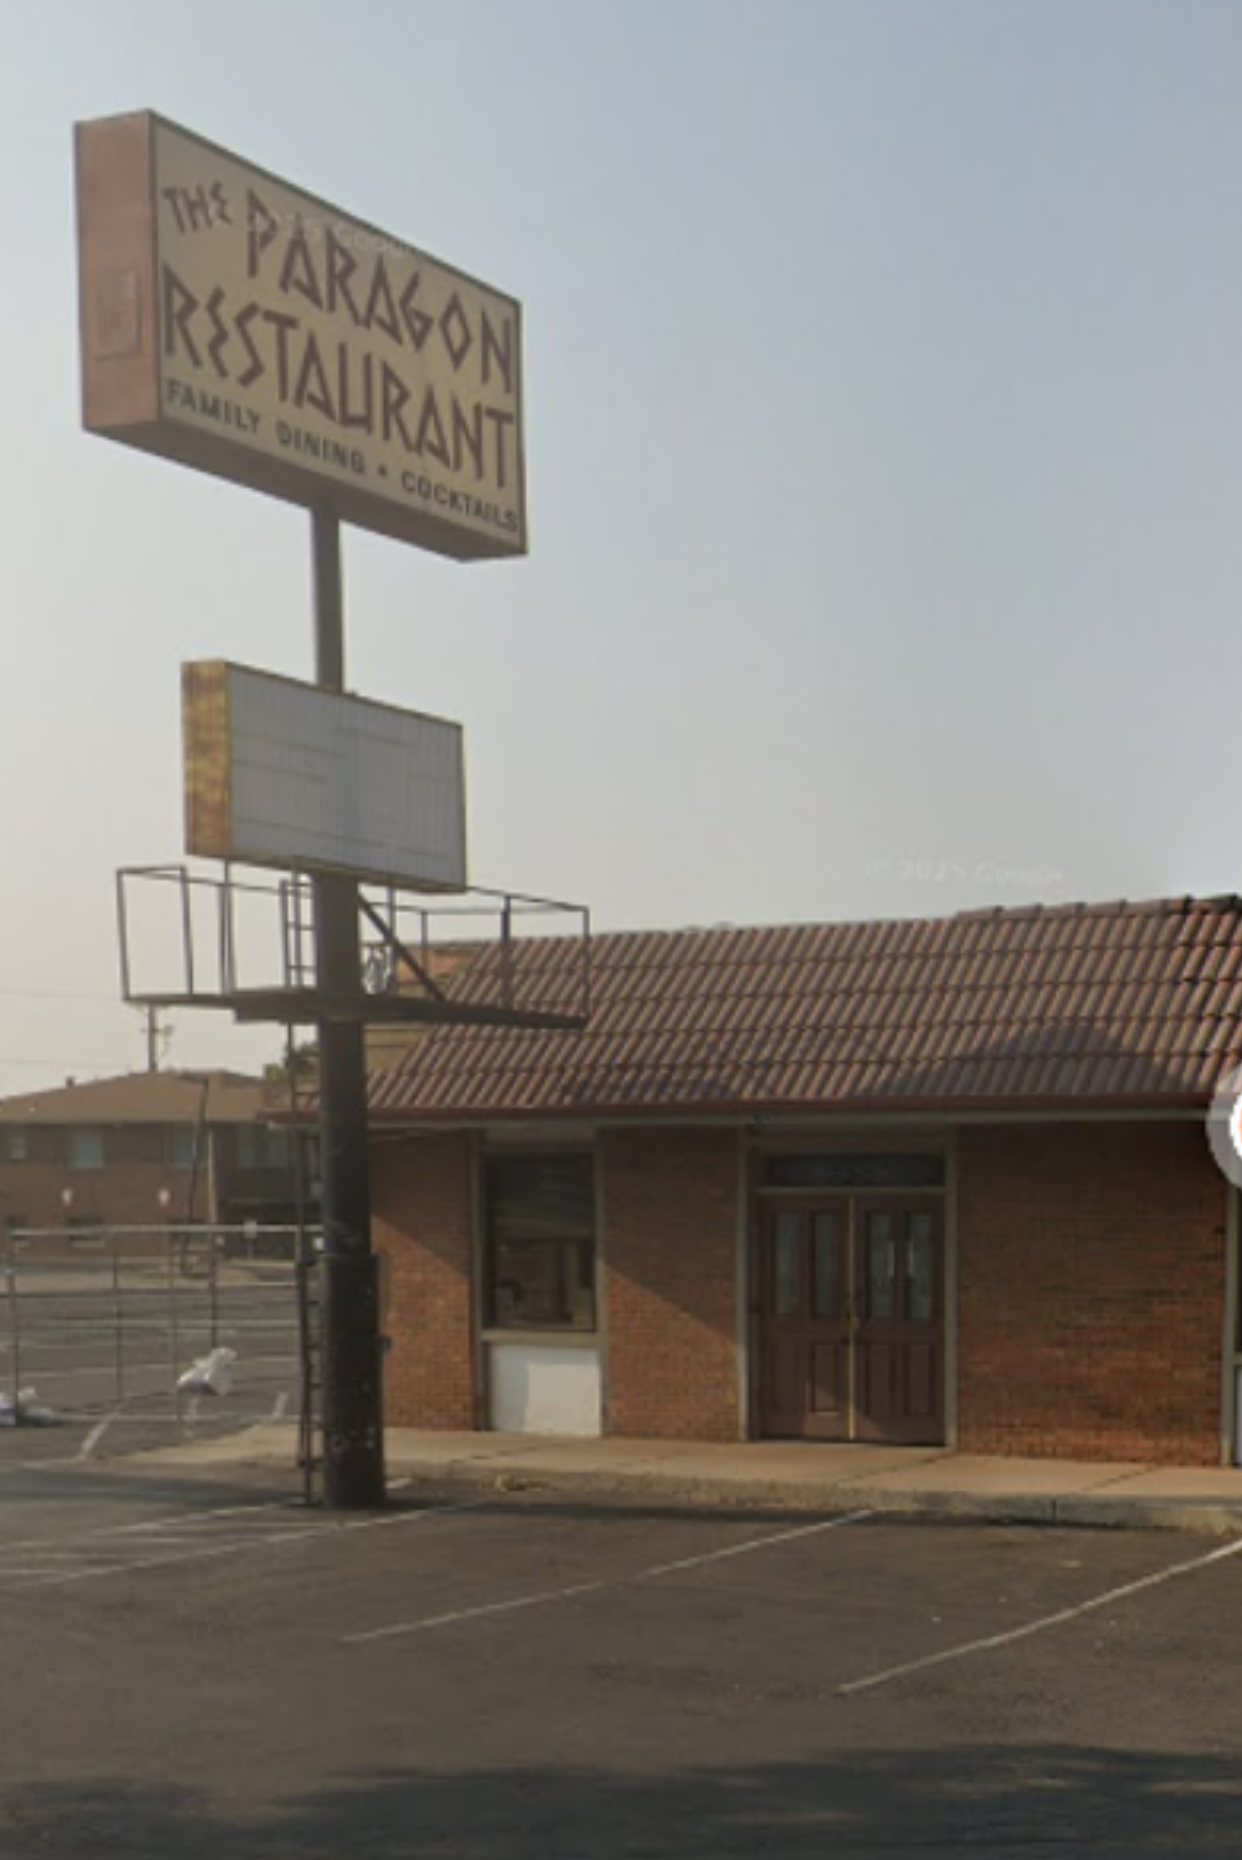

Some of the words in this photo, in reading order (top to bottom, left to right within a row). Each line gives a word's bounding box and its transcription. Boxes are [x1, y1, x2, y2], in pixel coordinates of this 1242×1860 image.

[162, 181, 233, 235] THE
[247, 187, 513, 394] PARAGON
[163, 261, 515, 489] RESTAURANT
[166, 378, 261, 433] FAMILY
[277, 420, 366, 475] DINING
[402, 470, 518, 534] COCKTAILS
